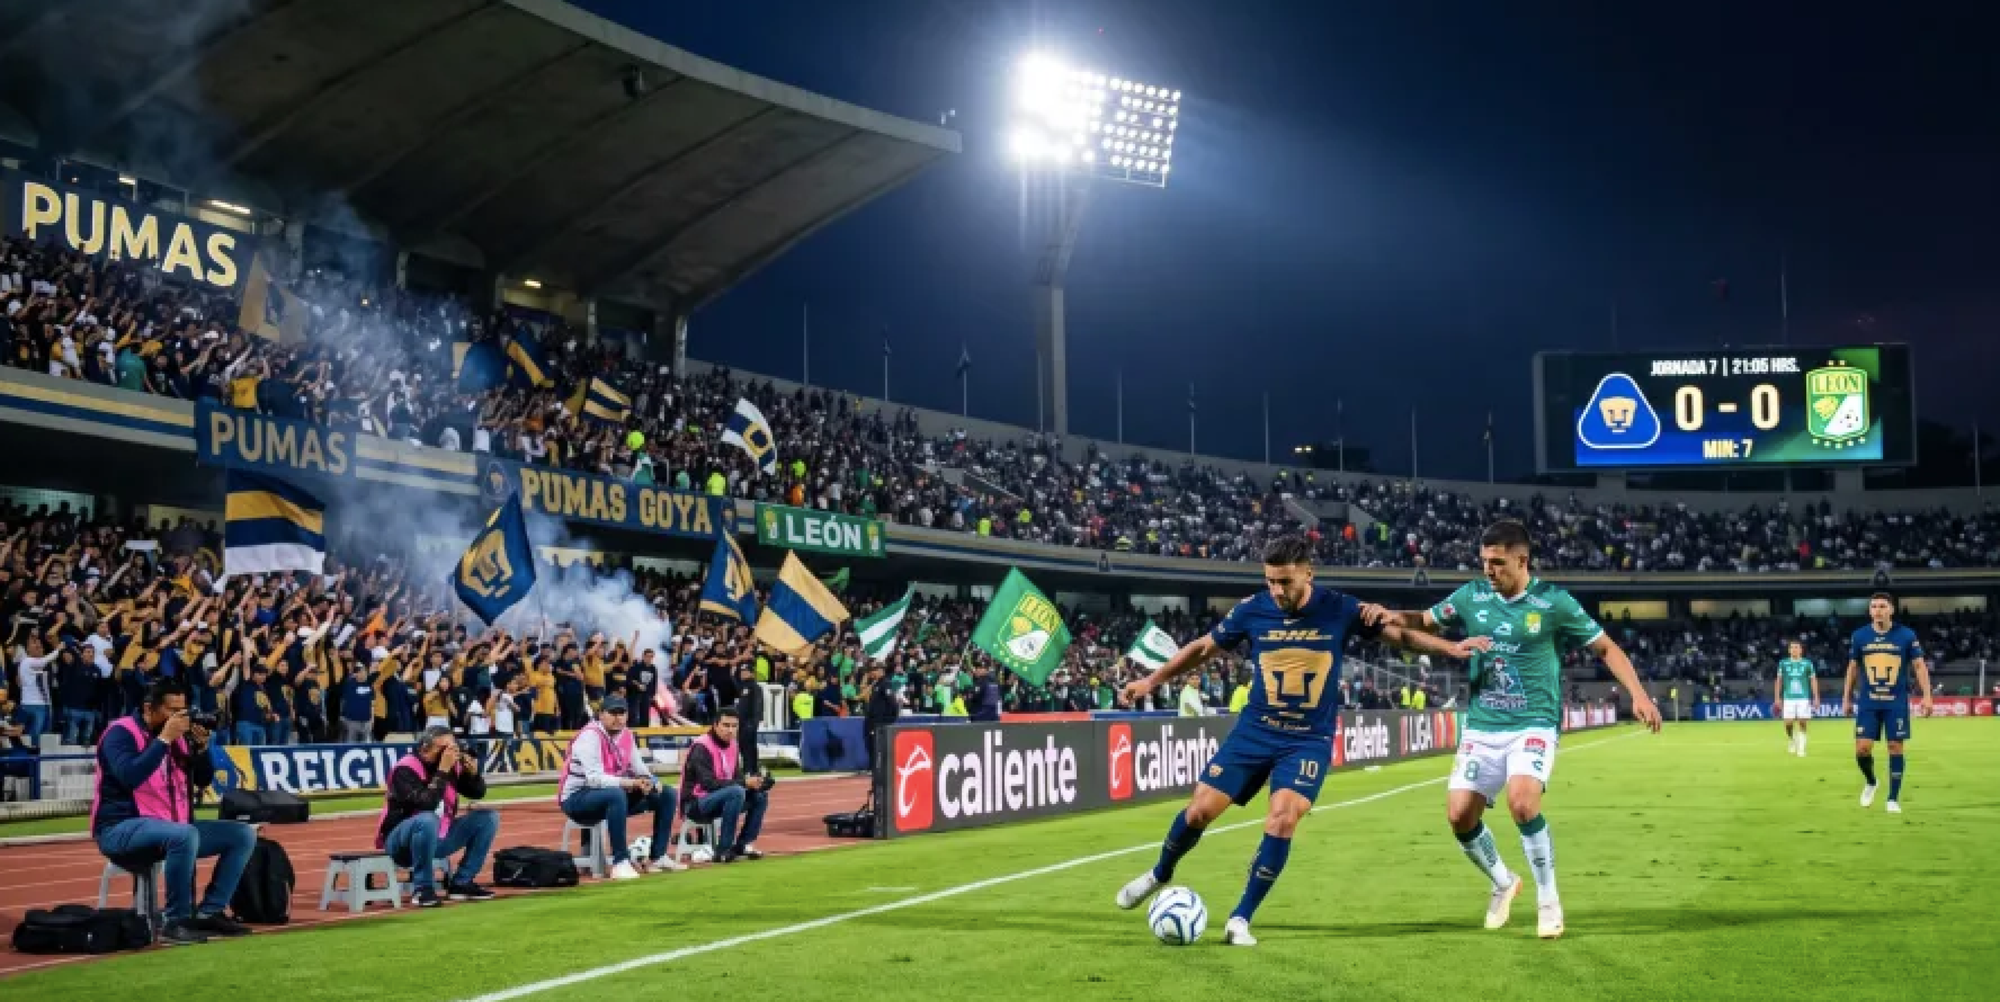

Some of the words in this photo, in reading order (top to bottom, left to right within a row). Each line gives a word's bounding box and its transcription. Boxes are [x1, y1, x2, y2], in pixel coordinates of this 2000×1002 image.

[22, 182, 238, 287] PUMAS
[1650, 360, 1707, 376] JORNADA
[1709, 359, 1717, 374] 7
[1731, 357, 1768, 374] 21:05
[1771, 357, 1800, 373] HRS.
[1675, 385, 1703, 431] 0
[1751, 384, 1779, 430] 0
[210, 411, 348, 475] PUMAS
[1702, 439, 1739, 459] MIN:
[1740, 439, 1753, 458] 7
[520, 468, 627, 522] PUMAS
[639, 488, 713, 534] GOYA
[785, 514, 862, 551] LEÓN
[938, 730, 1077, 819] caliente
[1299, 759, 1318, 779] 10
[1464, 760, 1480, 781] 8
